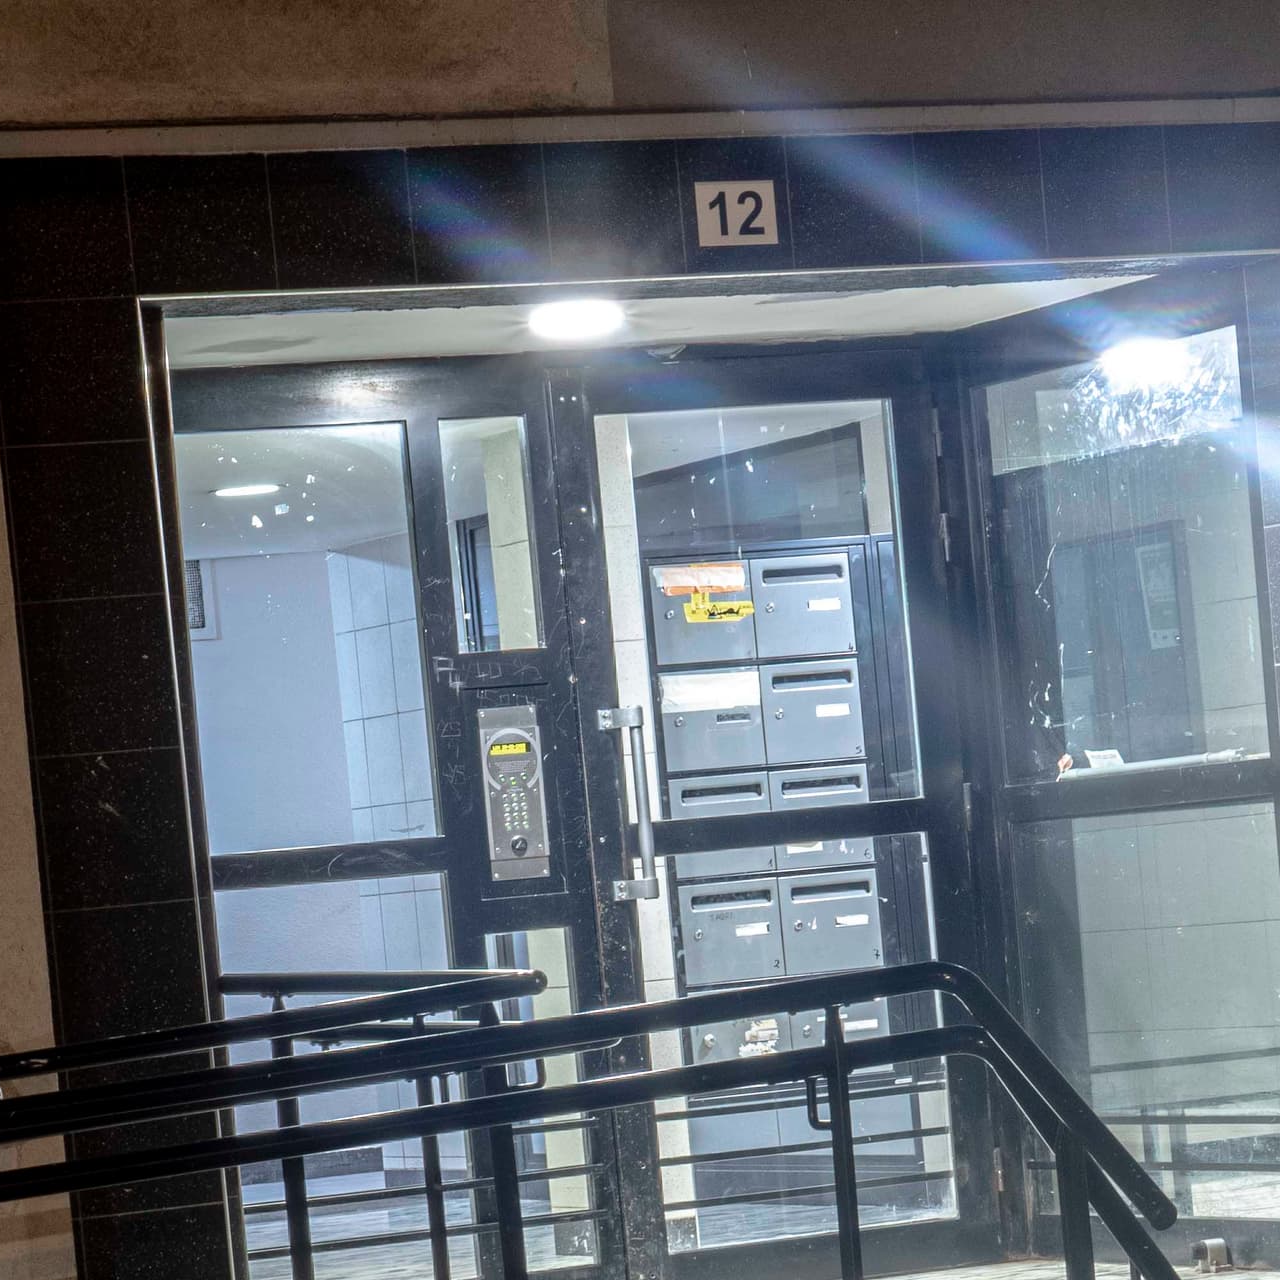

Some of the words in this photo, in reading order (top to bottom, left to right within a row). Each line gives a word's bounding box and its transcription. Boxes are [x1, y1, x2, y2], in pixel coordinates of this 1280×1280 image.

[708, 190, 765, 236] 12
[874, 949, 881, 959] 7
[773, 959, 780, 968] 2
